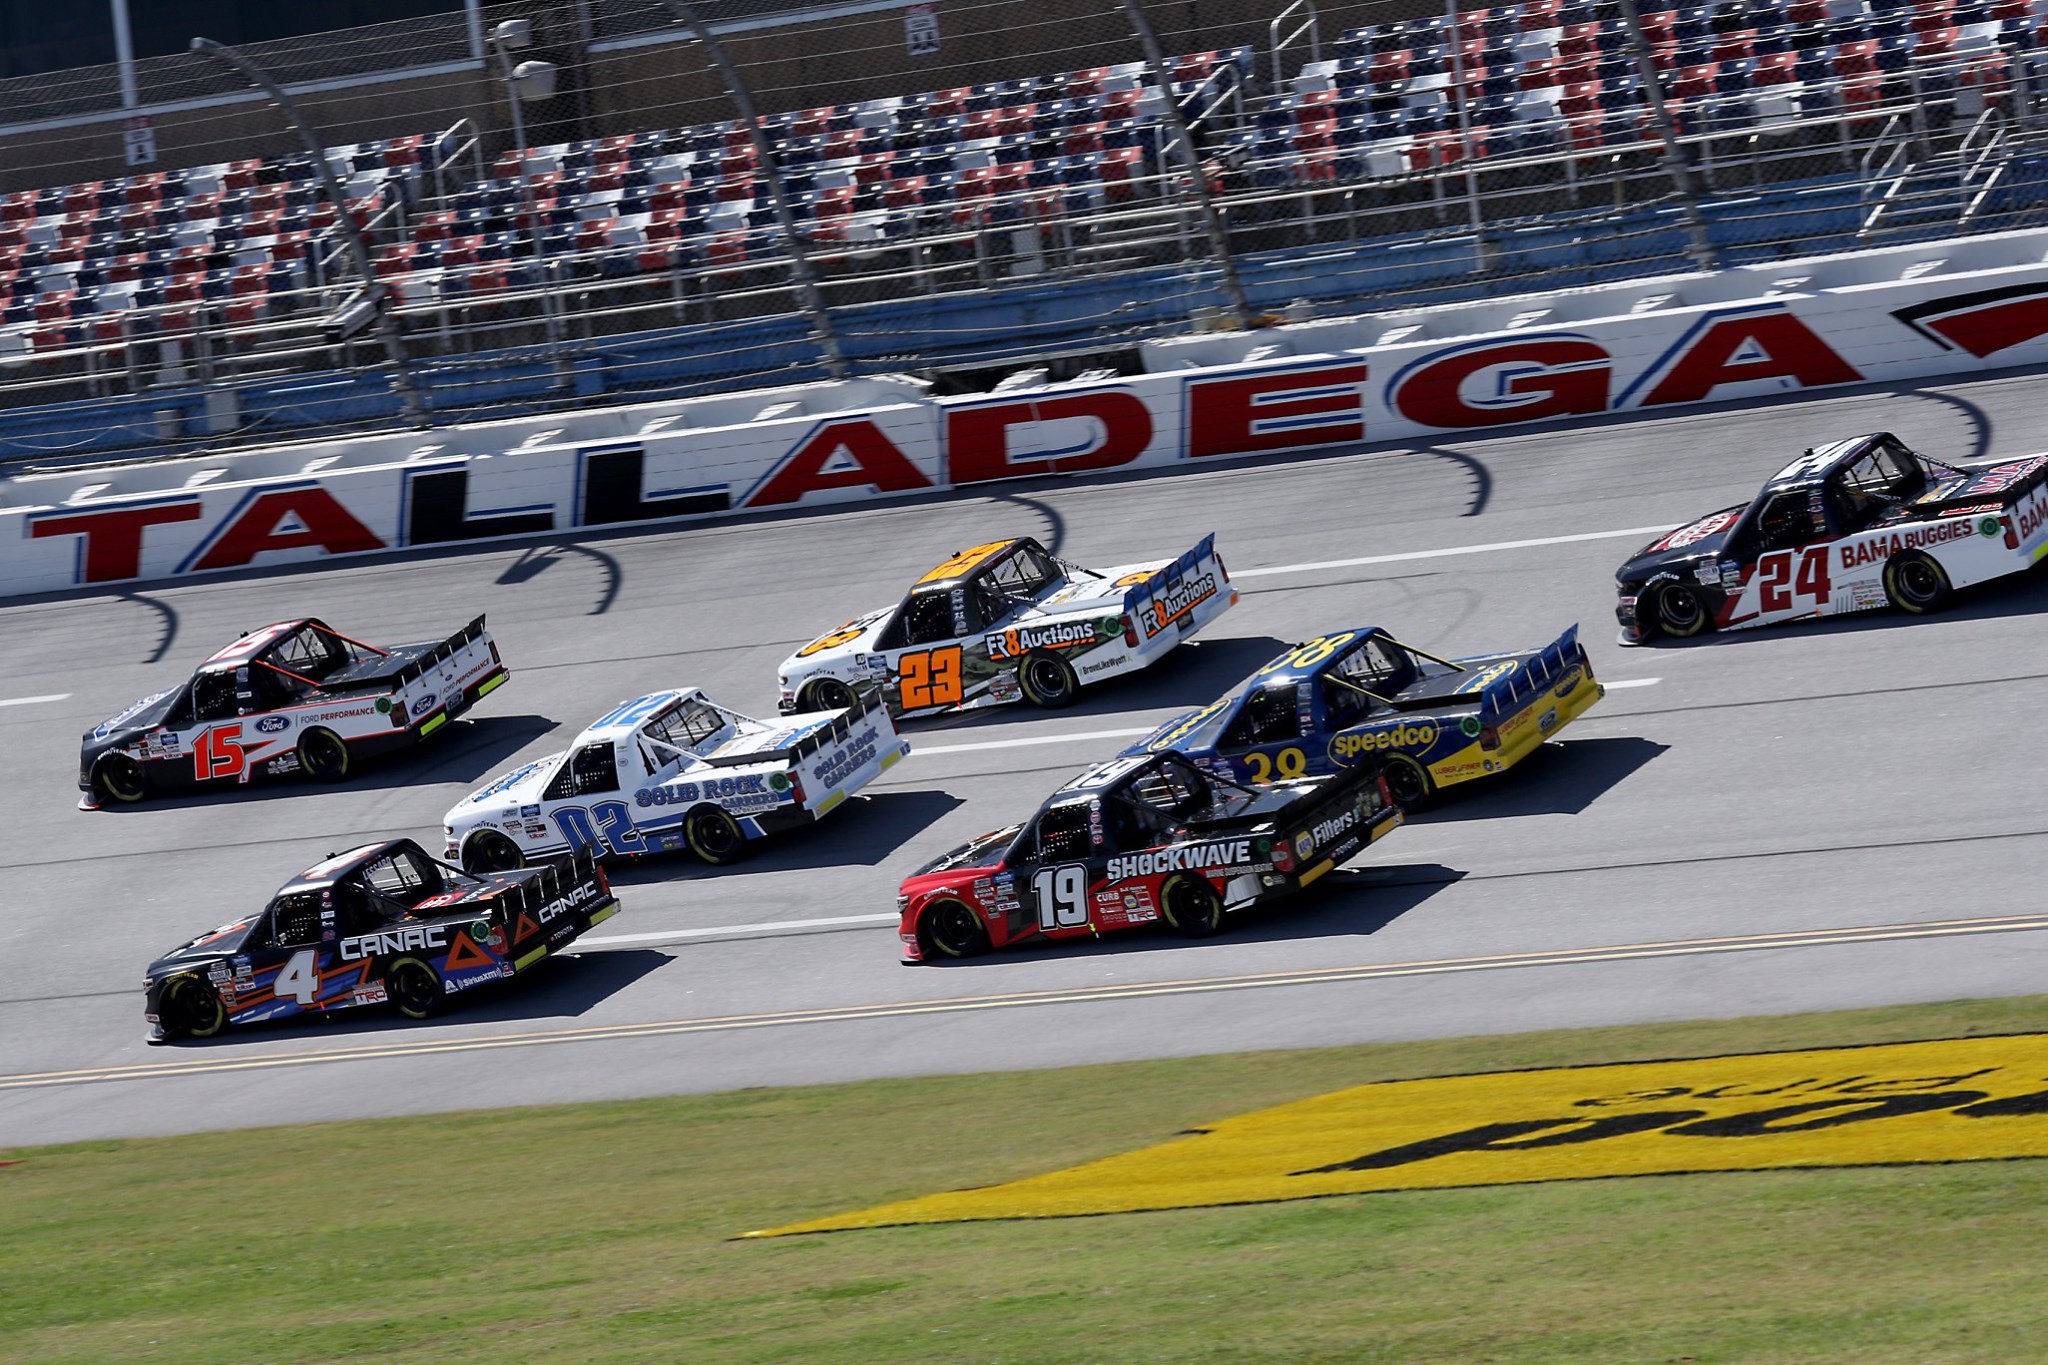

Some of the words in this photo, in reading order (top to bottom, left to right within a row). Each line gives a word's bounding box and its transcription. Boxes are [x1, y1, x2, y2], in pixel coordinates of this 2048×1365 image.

[24, 301, 1867, 584] TALLADEGA
[1841, 533, 1905, 569] BAMA
[1905, 518, 1973, 549] BUGGIES
[1759, 547, 1831, 613] 24
[455, 658, 490, 687] PERFORMANCE
[900, 646, 963, 710] 23
[261, 717, 285, 732] Ford
[301, 714, 319, 724] FORD
[320, 706, 375, 721] PERFORMANCE
[191, 723, 245, 781] 15
[1335, 723, 1434, 757] speedco
[634, 783, 700, 807] SOLID
[704, 773, 767, 800] ROCK
[549, 800, 648, 859] 02
[1312, 811, 1353, 848] Filters
[1107, 841, 1250, 880] SHOCKWAVE
[539, 880, 596, 924] CANAC
[1032, 864, 1089, 931] 19
[1096, 892, 1119, 902] CURB
[339, 927, 448, 961] CANAC
[554, 925, 574, 940] TOYOTA
[274, 950, 320, 1005] 4
